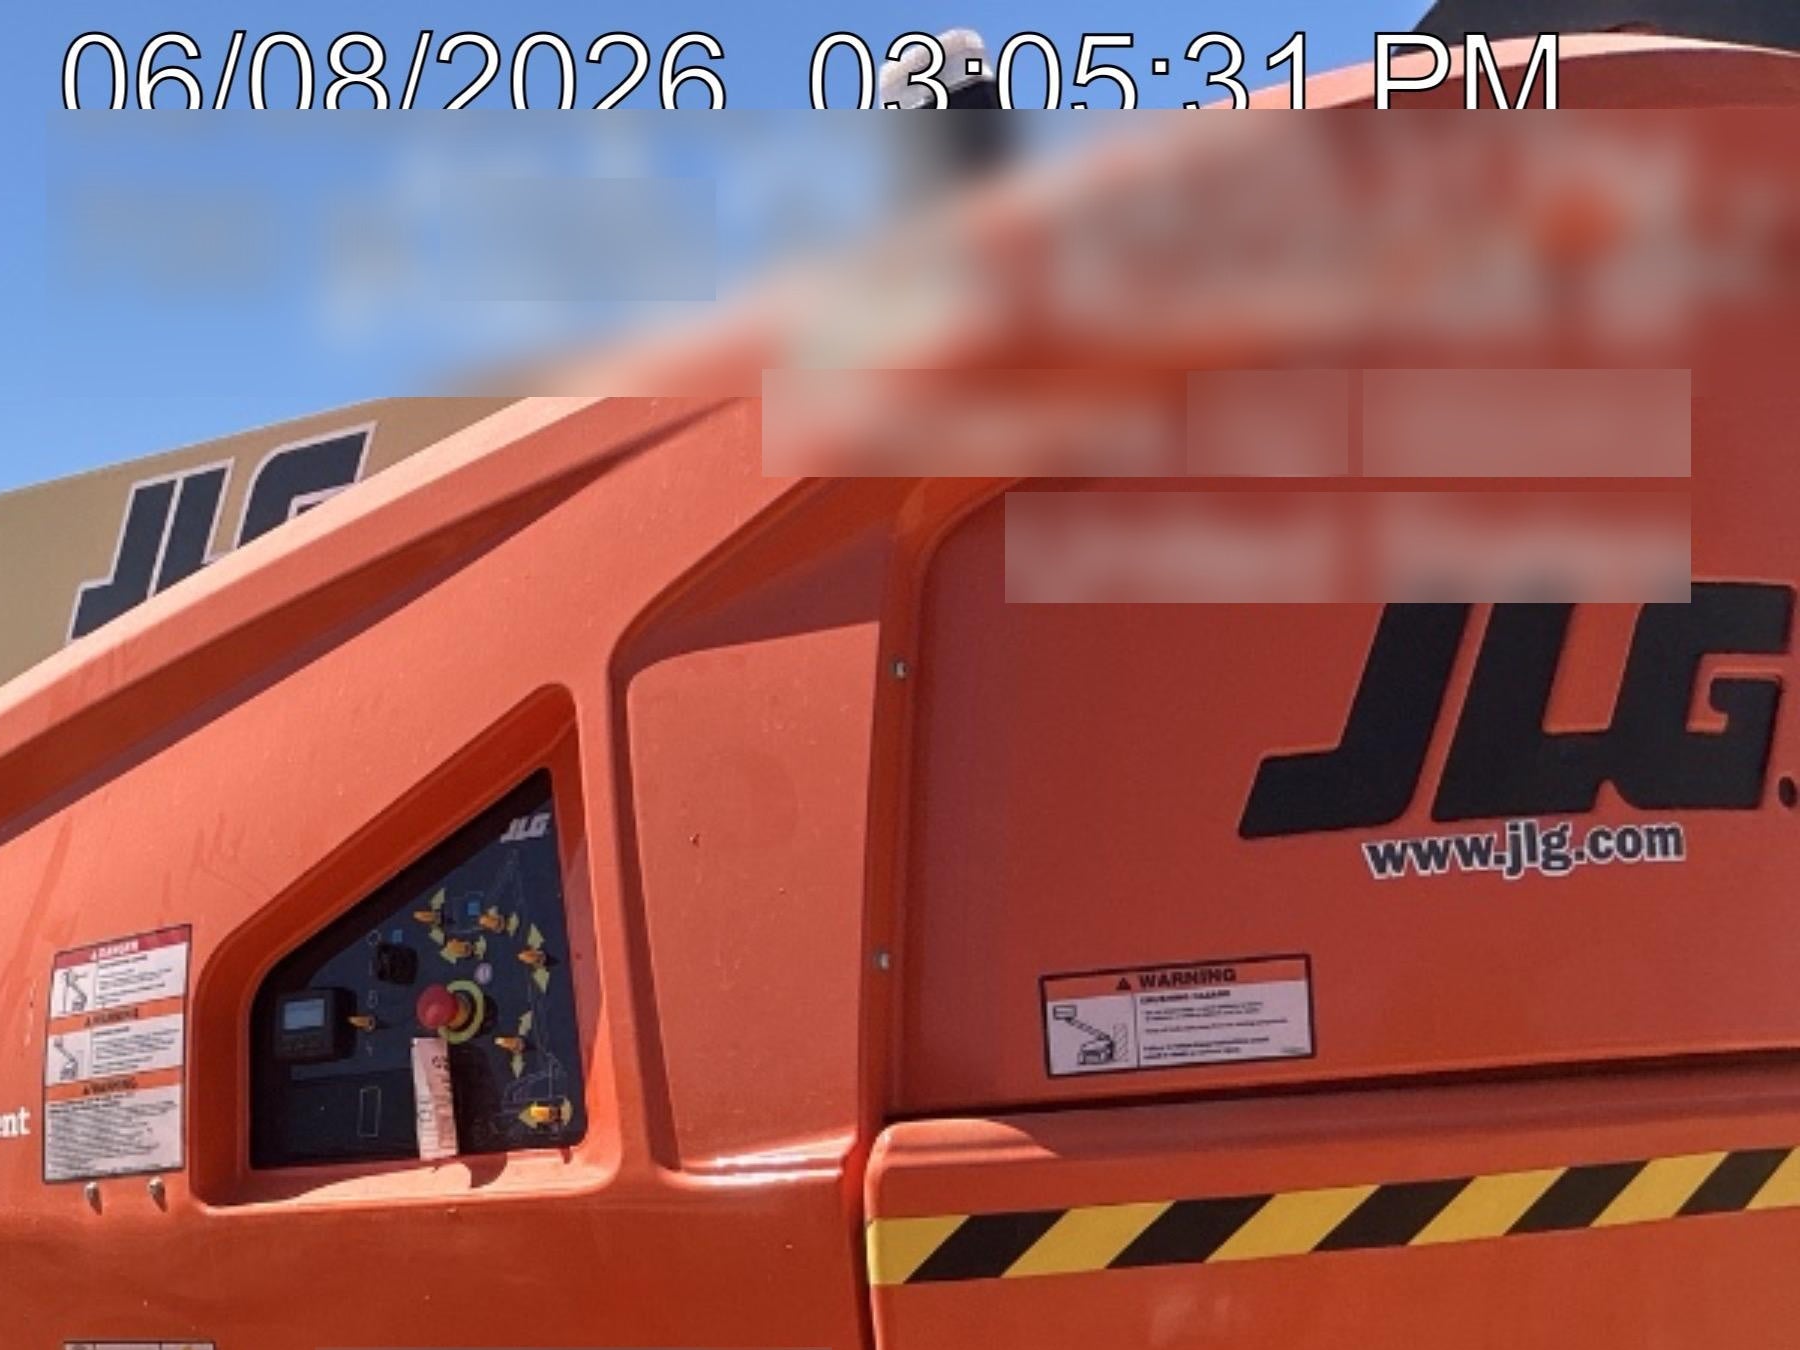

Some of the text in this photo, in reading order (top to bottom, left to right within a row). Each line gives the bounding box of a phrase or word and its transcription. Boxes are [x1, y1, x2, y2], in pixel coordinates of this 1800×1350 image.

[1238, 579, 1794, 838] JLG
[1363, 820, 1685, 877] www.jlg.com
[1138, 968, 1237, 989] WARNING
